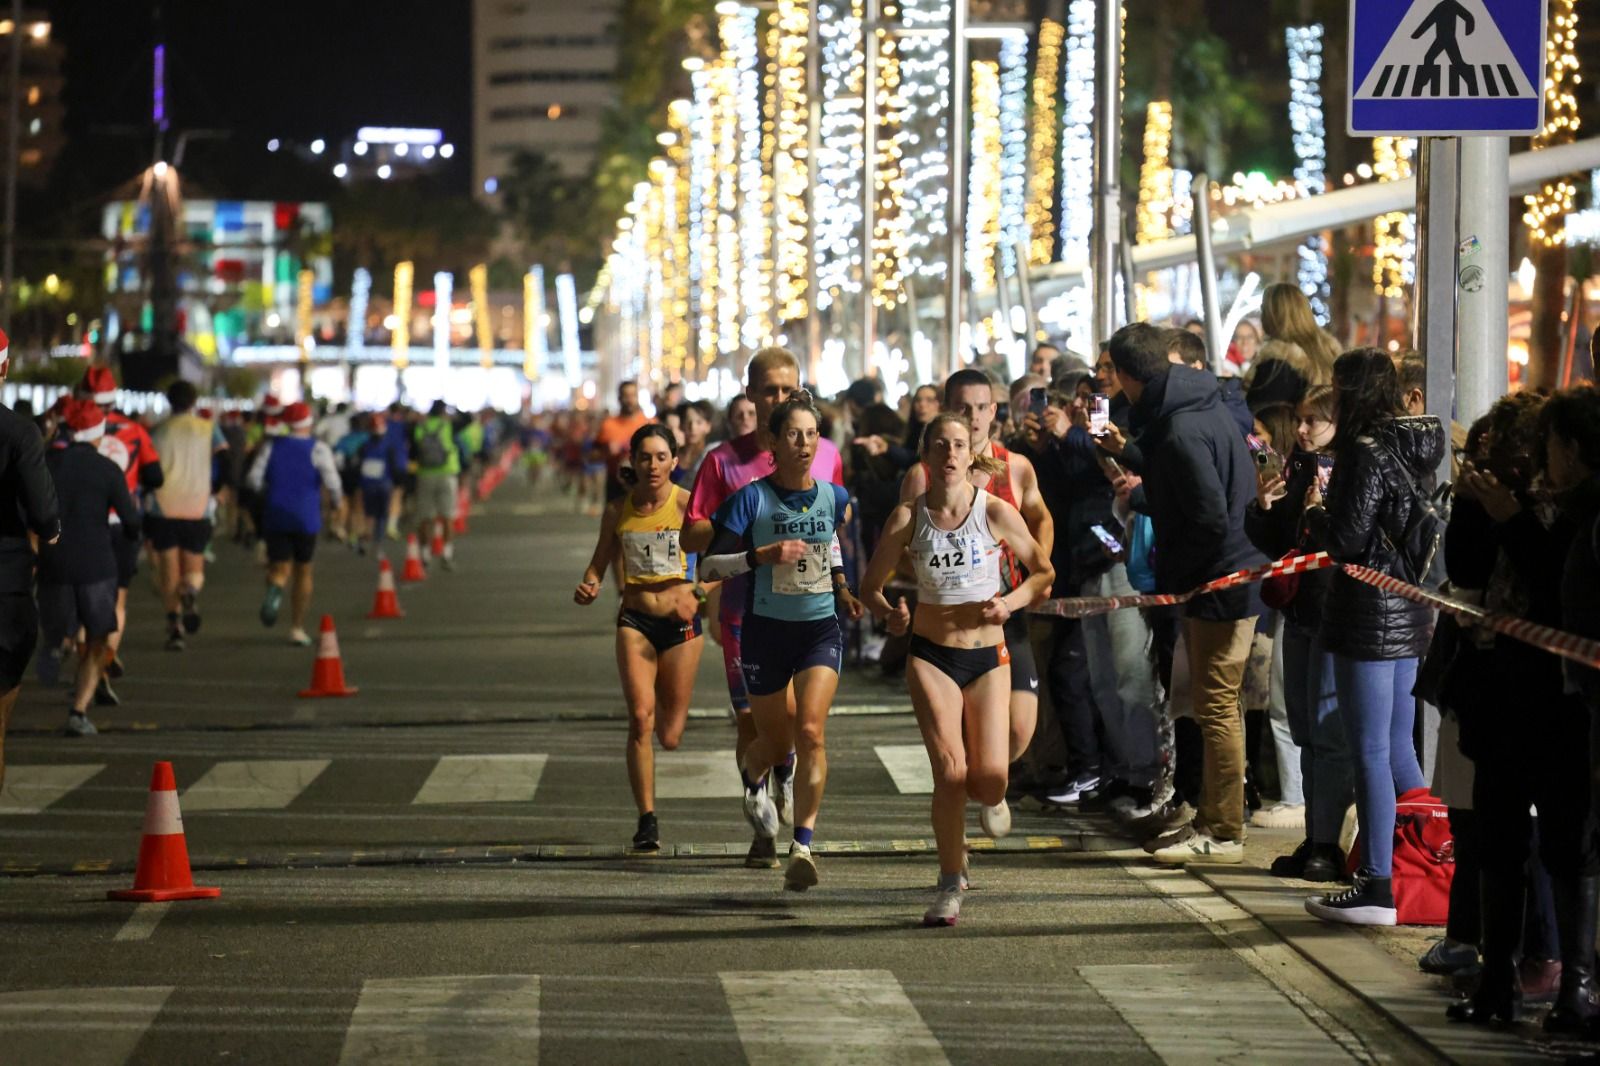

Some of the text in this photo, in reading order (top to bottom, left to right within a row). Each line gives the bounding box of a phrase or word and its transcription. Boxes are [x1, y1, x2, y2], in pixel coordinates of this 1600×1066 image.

[774, 516, 826, 535] nerja
[643, 544, 650, 557] 1
[797, 559, 807, 573] 5
[929, 552, 965, 569] 412
